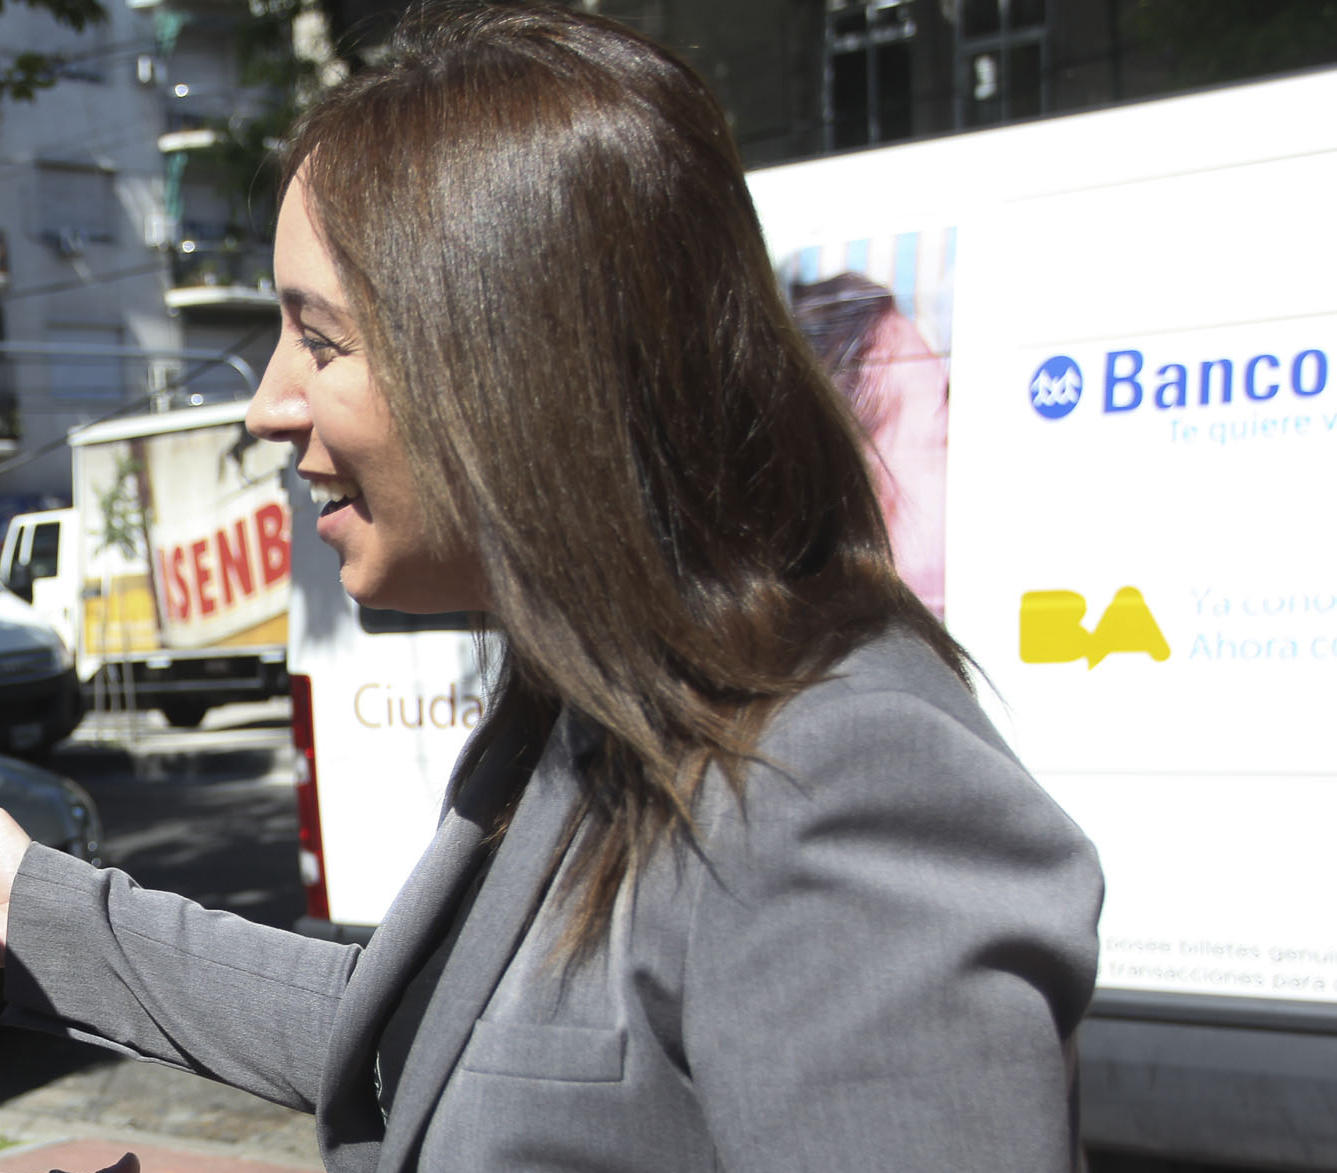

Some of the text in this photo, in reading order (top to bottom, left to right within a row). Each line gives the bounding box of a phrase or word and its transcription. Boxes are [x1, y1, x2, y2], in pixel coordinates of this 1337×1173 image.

[1103, 349, 1329, 413] Banco
[1169, 417, 1199, 444] Te
[1209, 410, 1311, 446] quiere
[158, 501, 292, 622] ISENB
[1019, 586, 1171, 670] BA
[1189, 631, 1298, 661] Ahora
[354, 681, 485, 729] Ciuda
[1110, 960, 1265, 987] transacciones
[1272, 972, 1326, 992] para
[1268, 945, 1337, 965] genui
